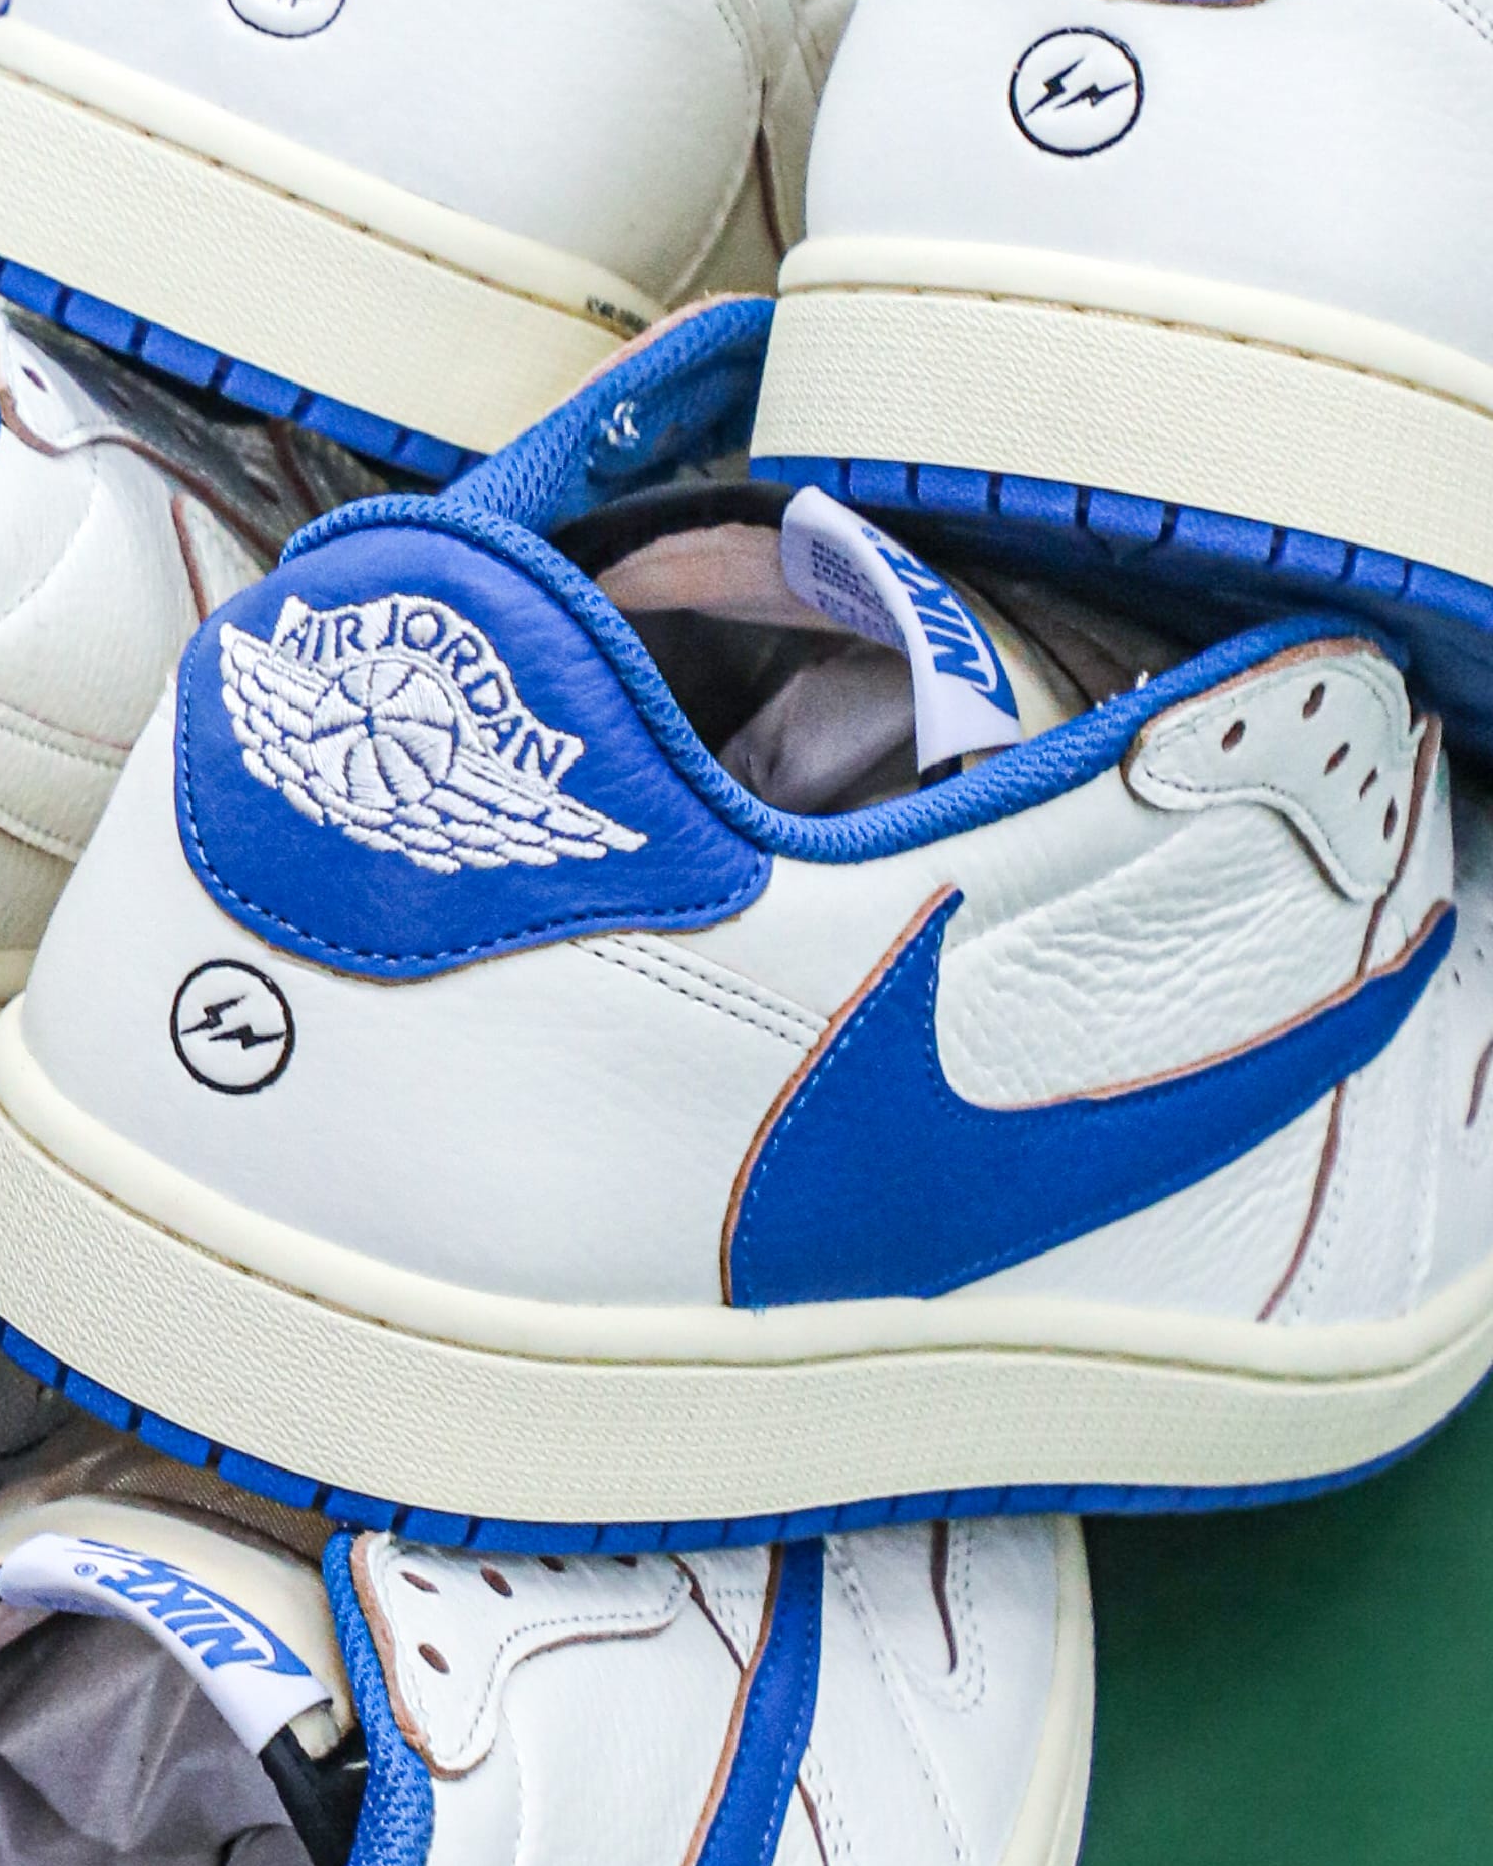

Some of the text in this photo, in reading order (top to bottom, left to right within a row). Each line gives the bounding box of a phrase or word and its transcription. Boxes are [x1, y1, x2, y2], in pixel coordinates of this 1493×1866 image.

[876, 547, 991, 687] NIKE
[281, 604, 566, 779] AIR JORDAN
[96, 1558, 268, 1670] NIKE
